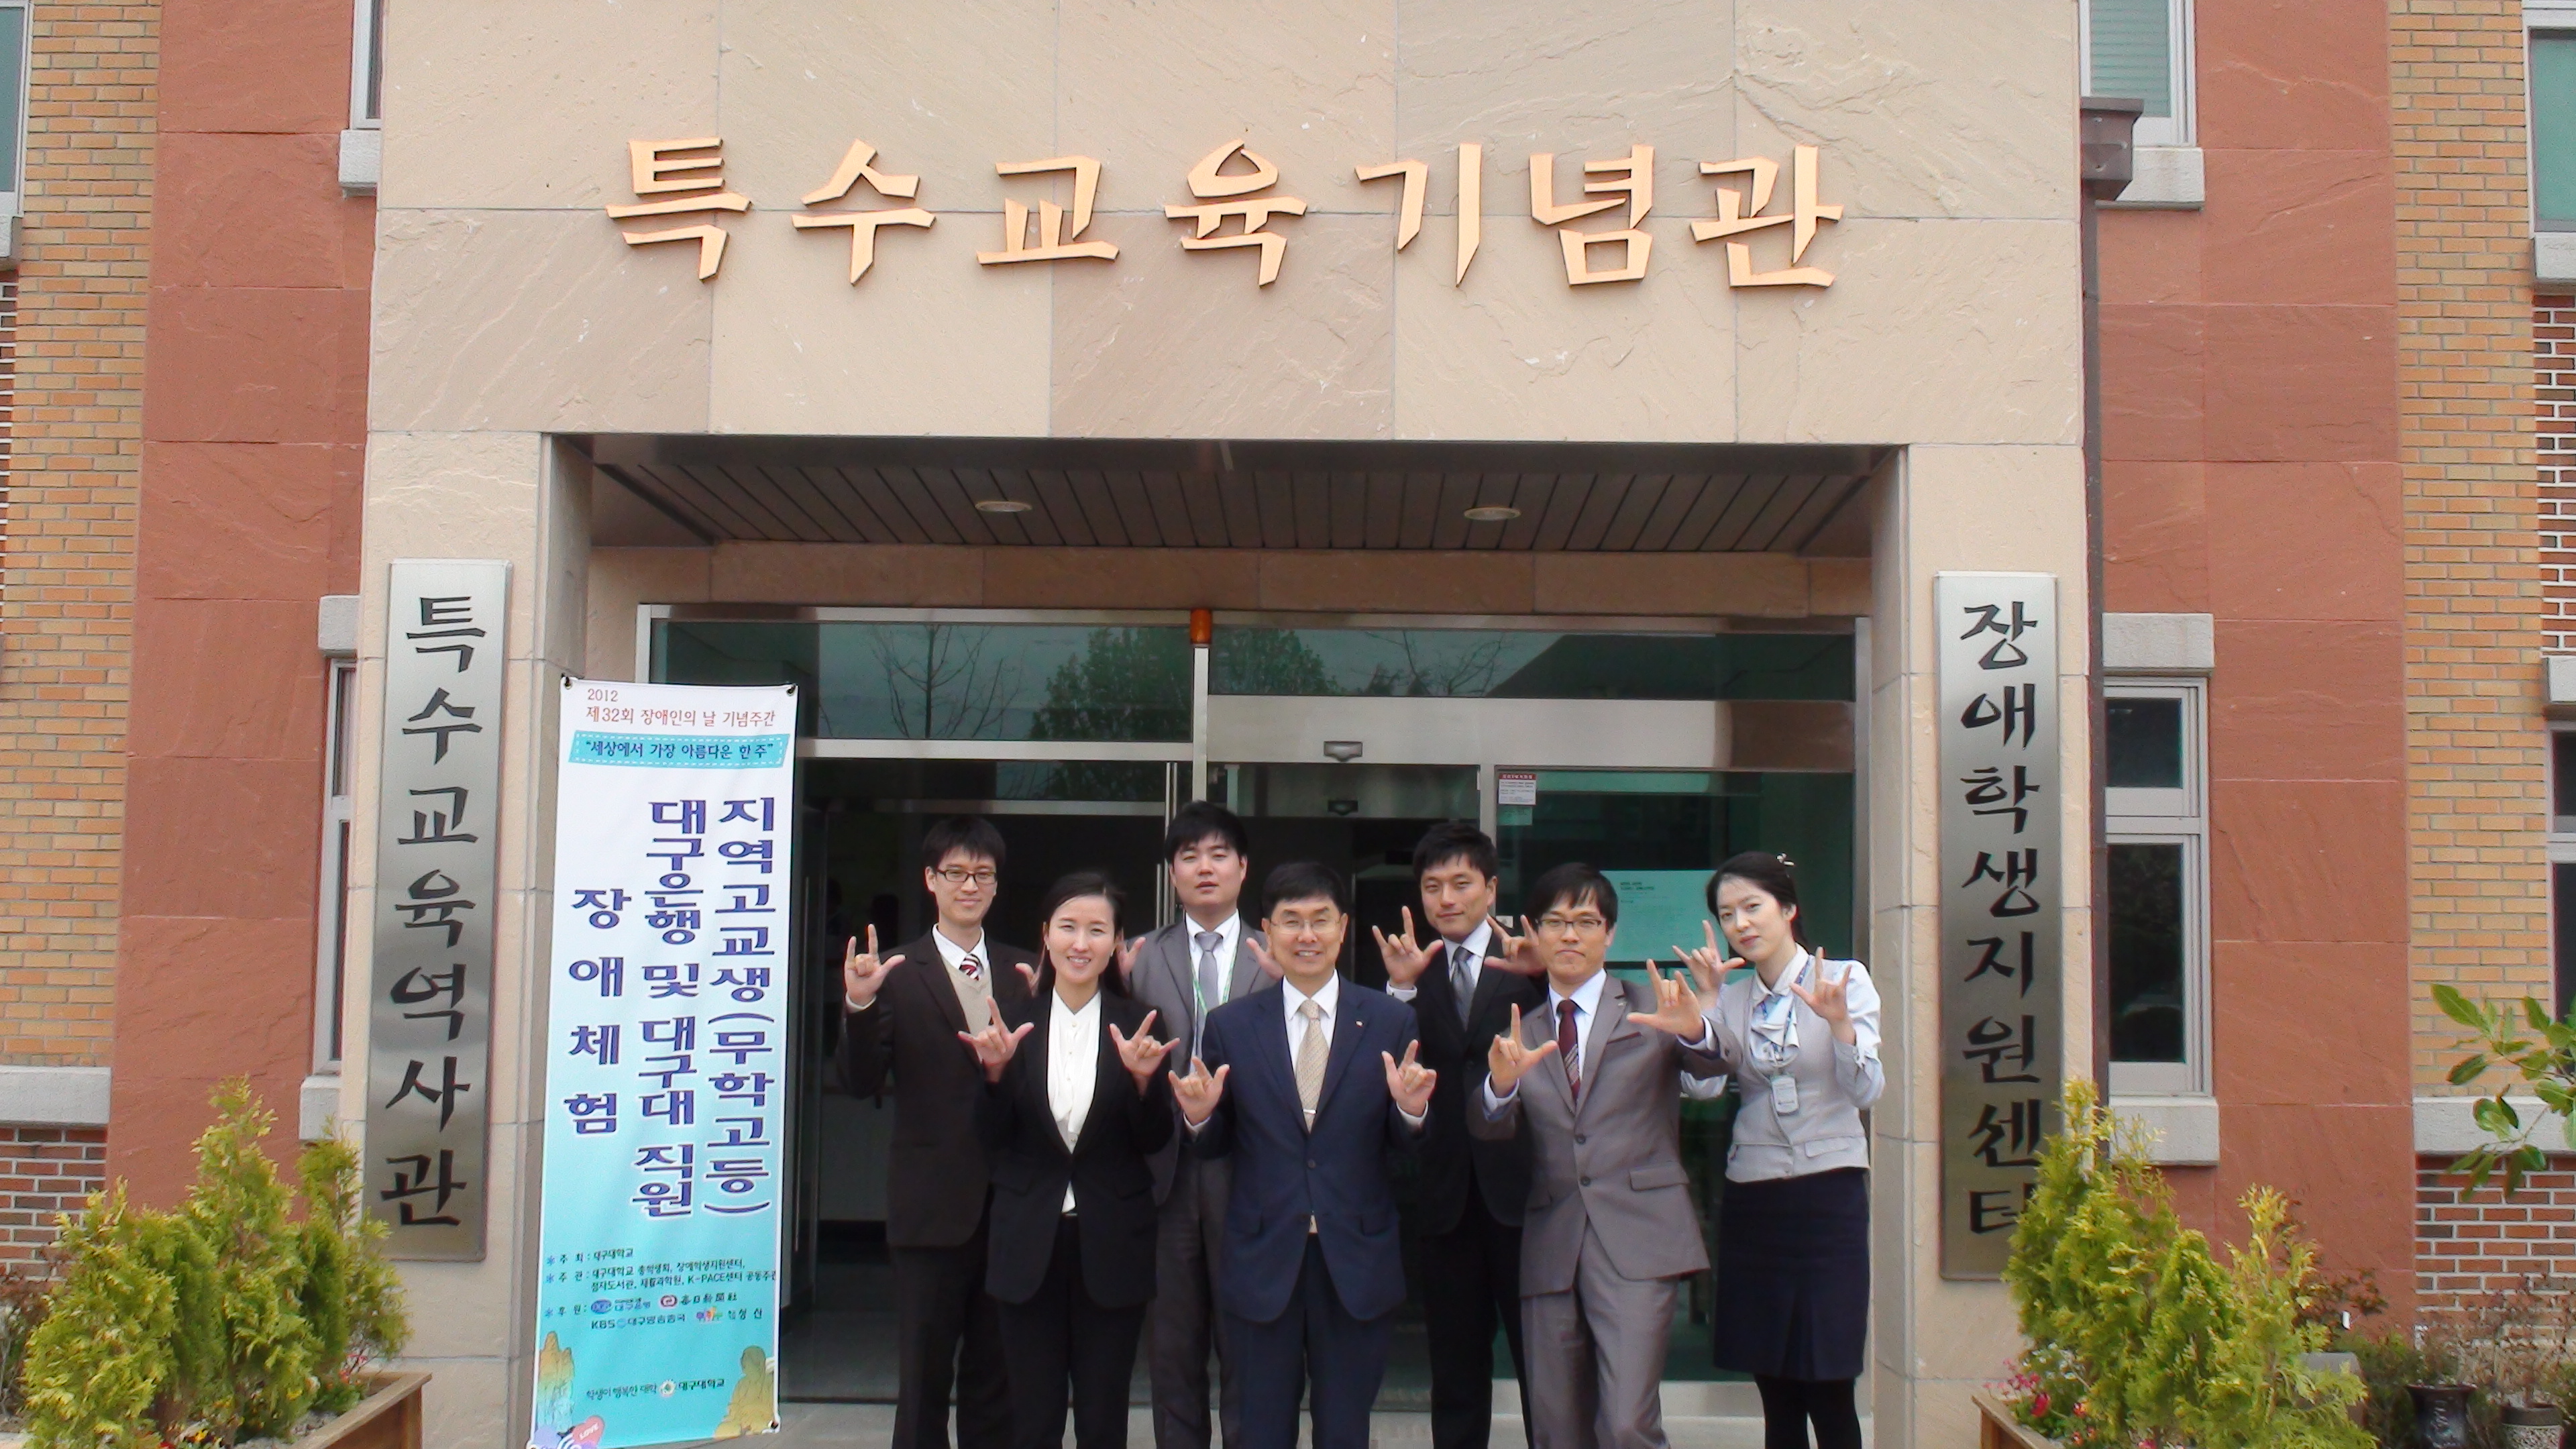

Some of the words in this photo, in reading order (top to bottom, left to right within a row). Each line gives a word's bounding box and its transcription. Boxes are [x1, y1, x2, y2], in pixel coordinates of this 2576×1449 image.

[605, 138, 1845, 287] 특수교육기념관
[586, 706, 634, 724] 제32회
[641, 708, 696, 727] 장애인의
[702, 710, 716, 727] 날
[722, 710, 775, 727] 기념주간
[588, 688, 619, 702] 2012
[650, 743, 676, 759] 가장
[682, 745, 733, 759] 아름다운
[739, 745, 751, 759] 한
[645, 800, 706, 945] 대구은행
[380, 596, 486, 1227] 특수교육역사관
[642, 963, 699, 999] 및
[639, 1016, 697, 1125] 대구대
[633, 1144, 694, 1218] 직원
